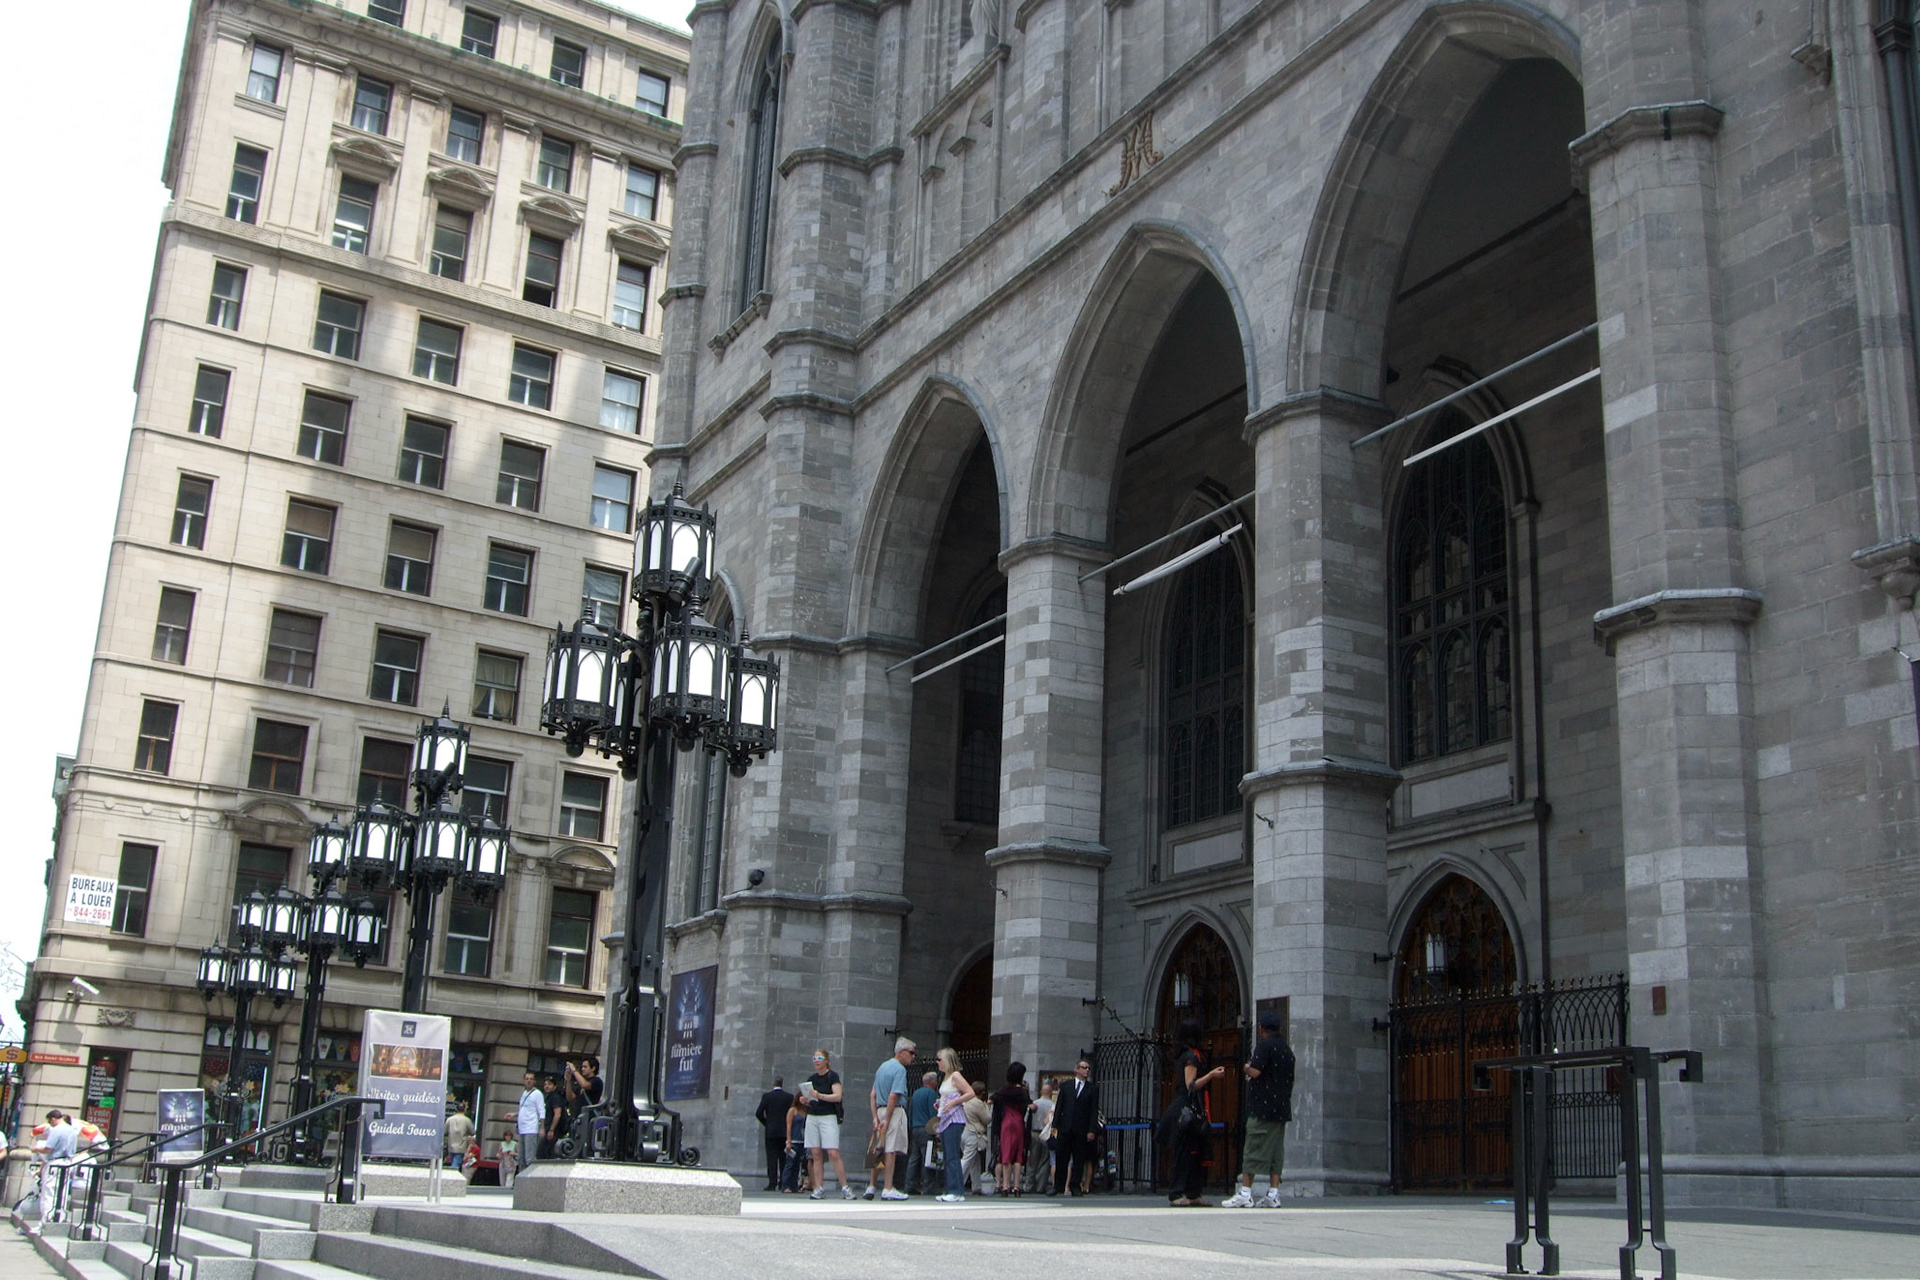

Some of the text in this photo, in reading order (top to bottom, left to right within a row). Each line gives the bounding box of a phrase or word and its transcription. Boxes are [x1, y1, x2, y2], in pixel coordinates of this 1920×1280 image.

[72, 877, 115, 893] BUREAUX
[81, 893, 112, 908] LOUER
[671, 1043, 702, 1059] lumière
[679, 1057, 694, 1072] fut
[367, 1087, 441, 1106] Visites guidées
[368, 1121, 437, 1137] Guided Tours
